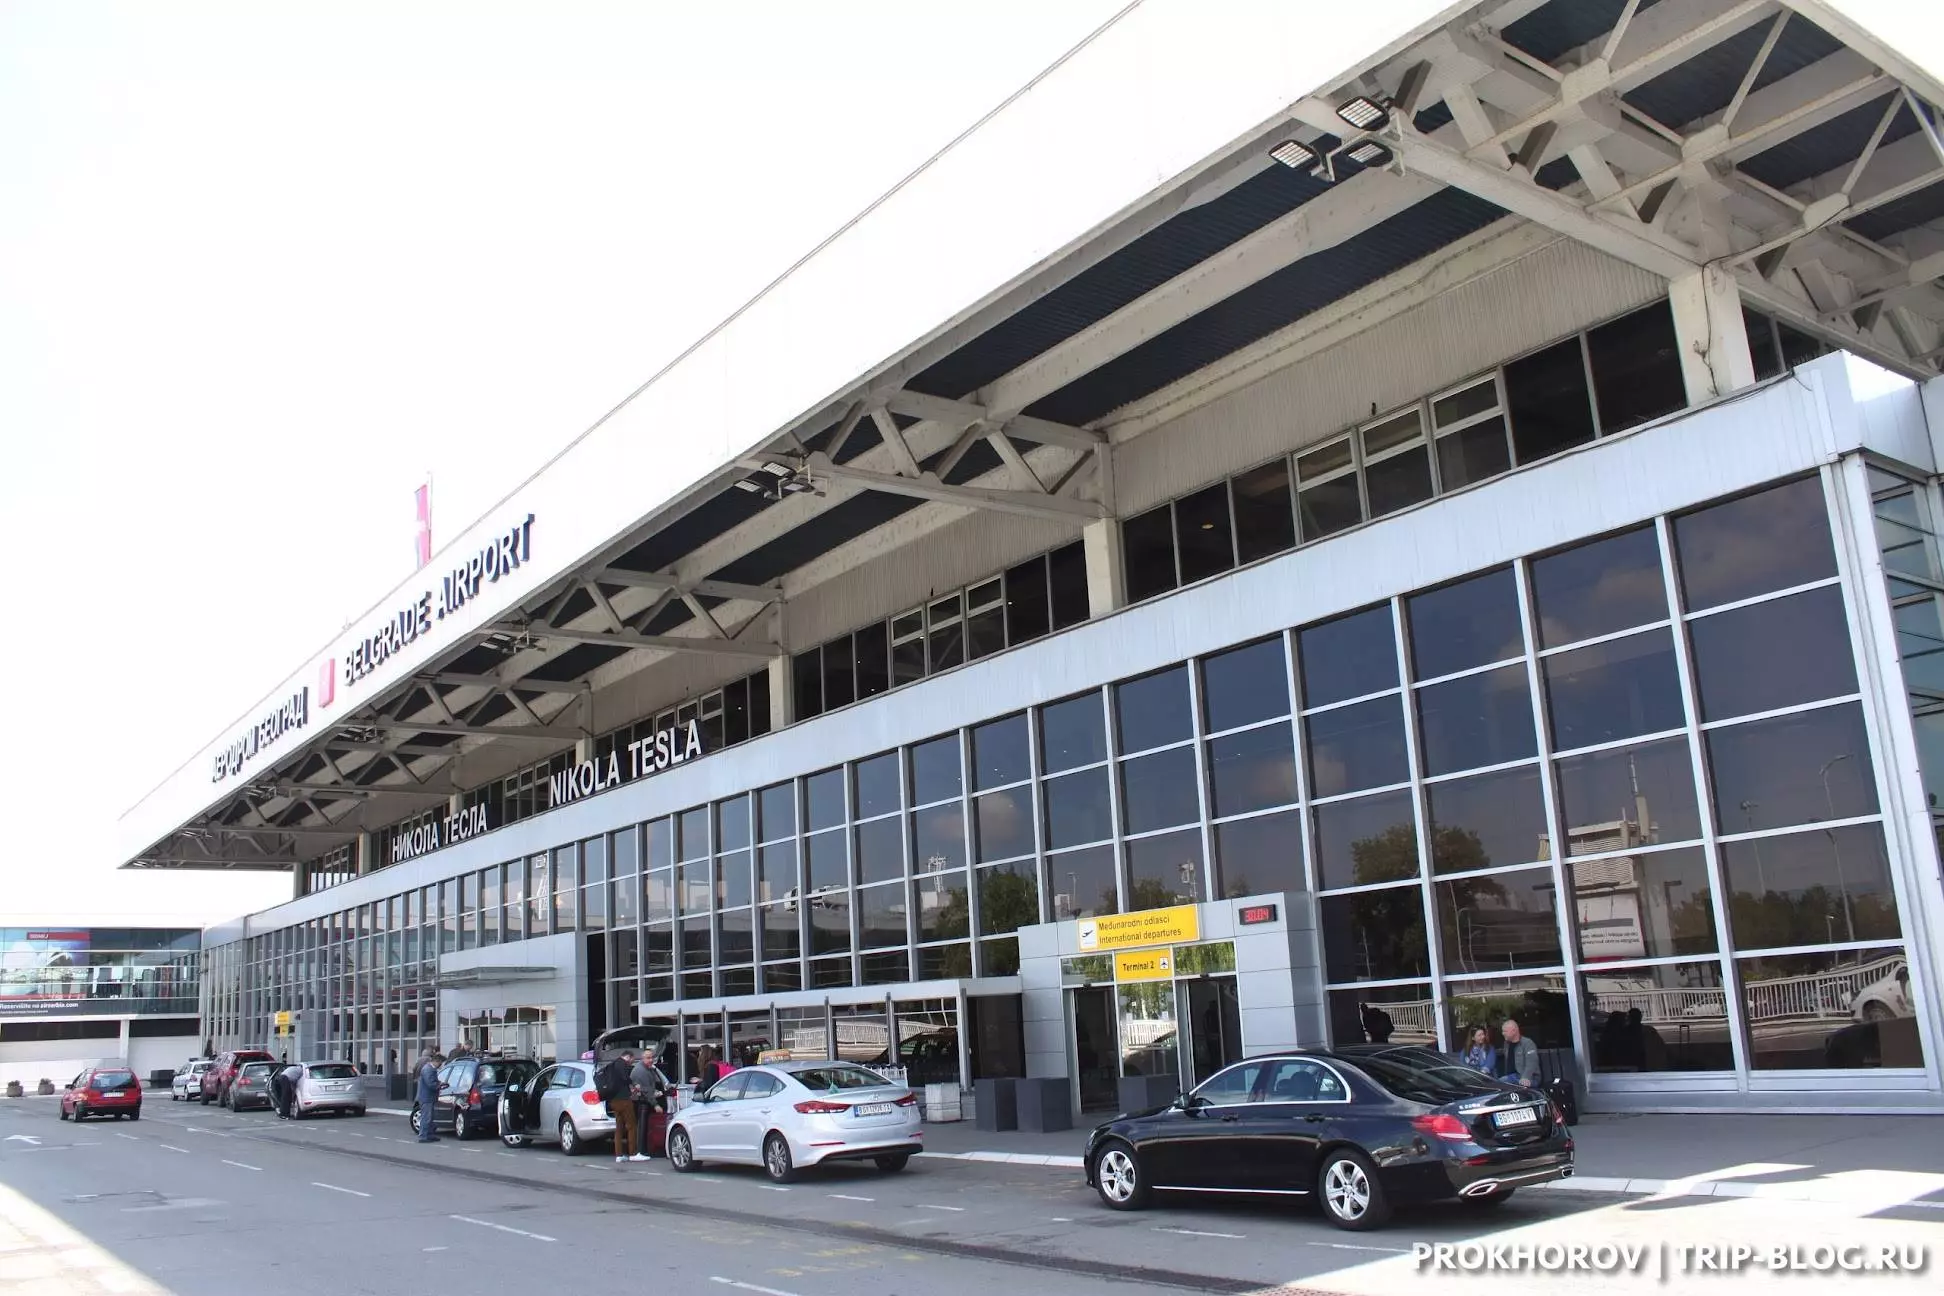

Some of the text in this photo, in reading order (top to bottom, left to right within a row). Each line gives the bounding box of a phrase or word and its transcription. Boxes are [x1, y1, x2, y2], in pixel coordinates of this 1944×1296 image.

[343, 513, 535, 686] BELGRADE AIRPORT
[260, 686, 309, 748] БЕОГРАД
[549, 718, 702, 807] NIKOLA TESLA
[392, 803, 488, 864] НИКОЛА ТЕСЛА
[1099, 928, 1182, 945] International departures
[1122, 960, 1155, 972] Terminal 2
